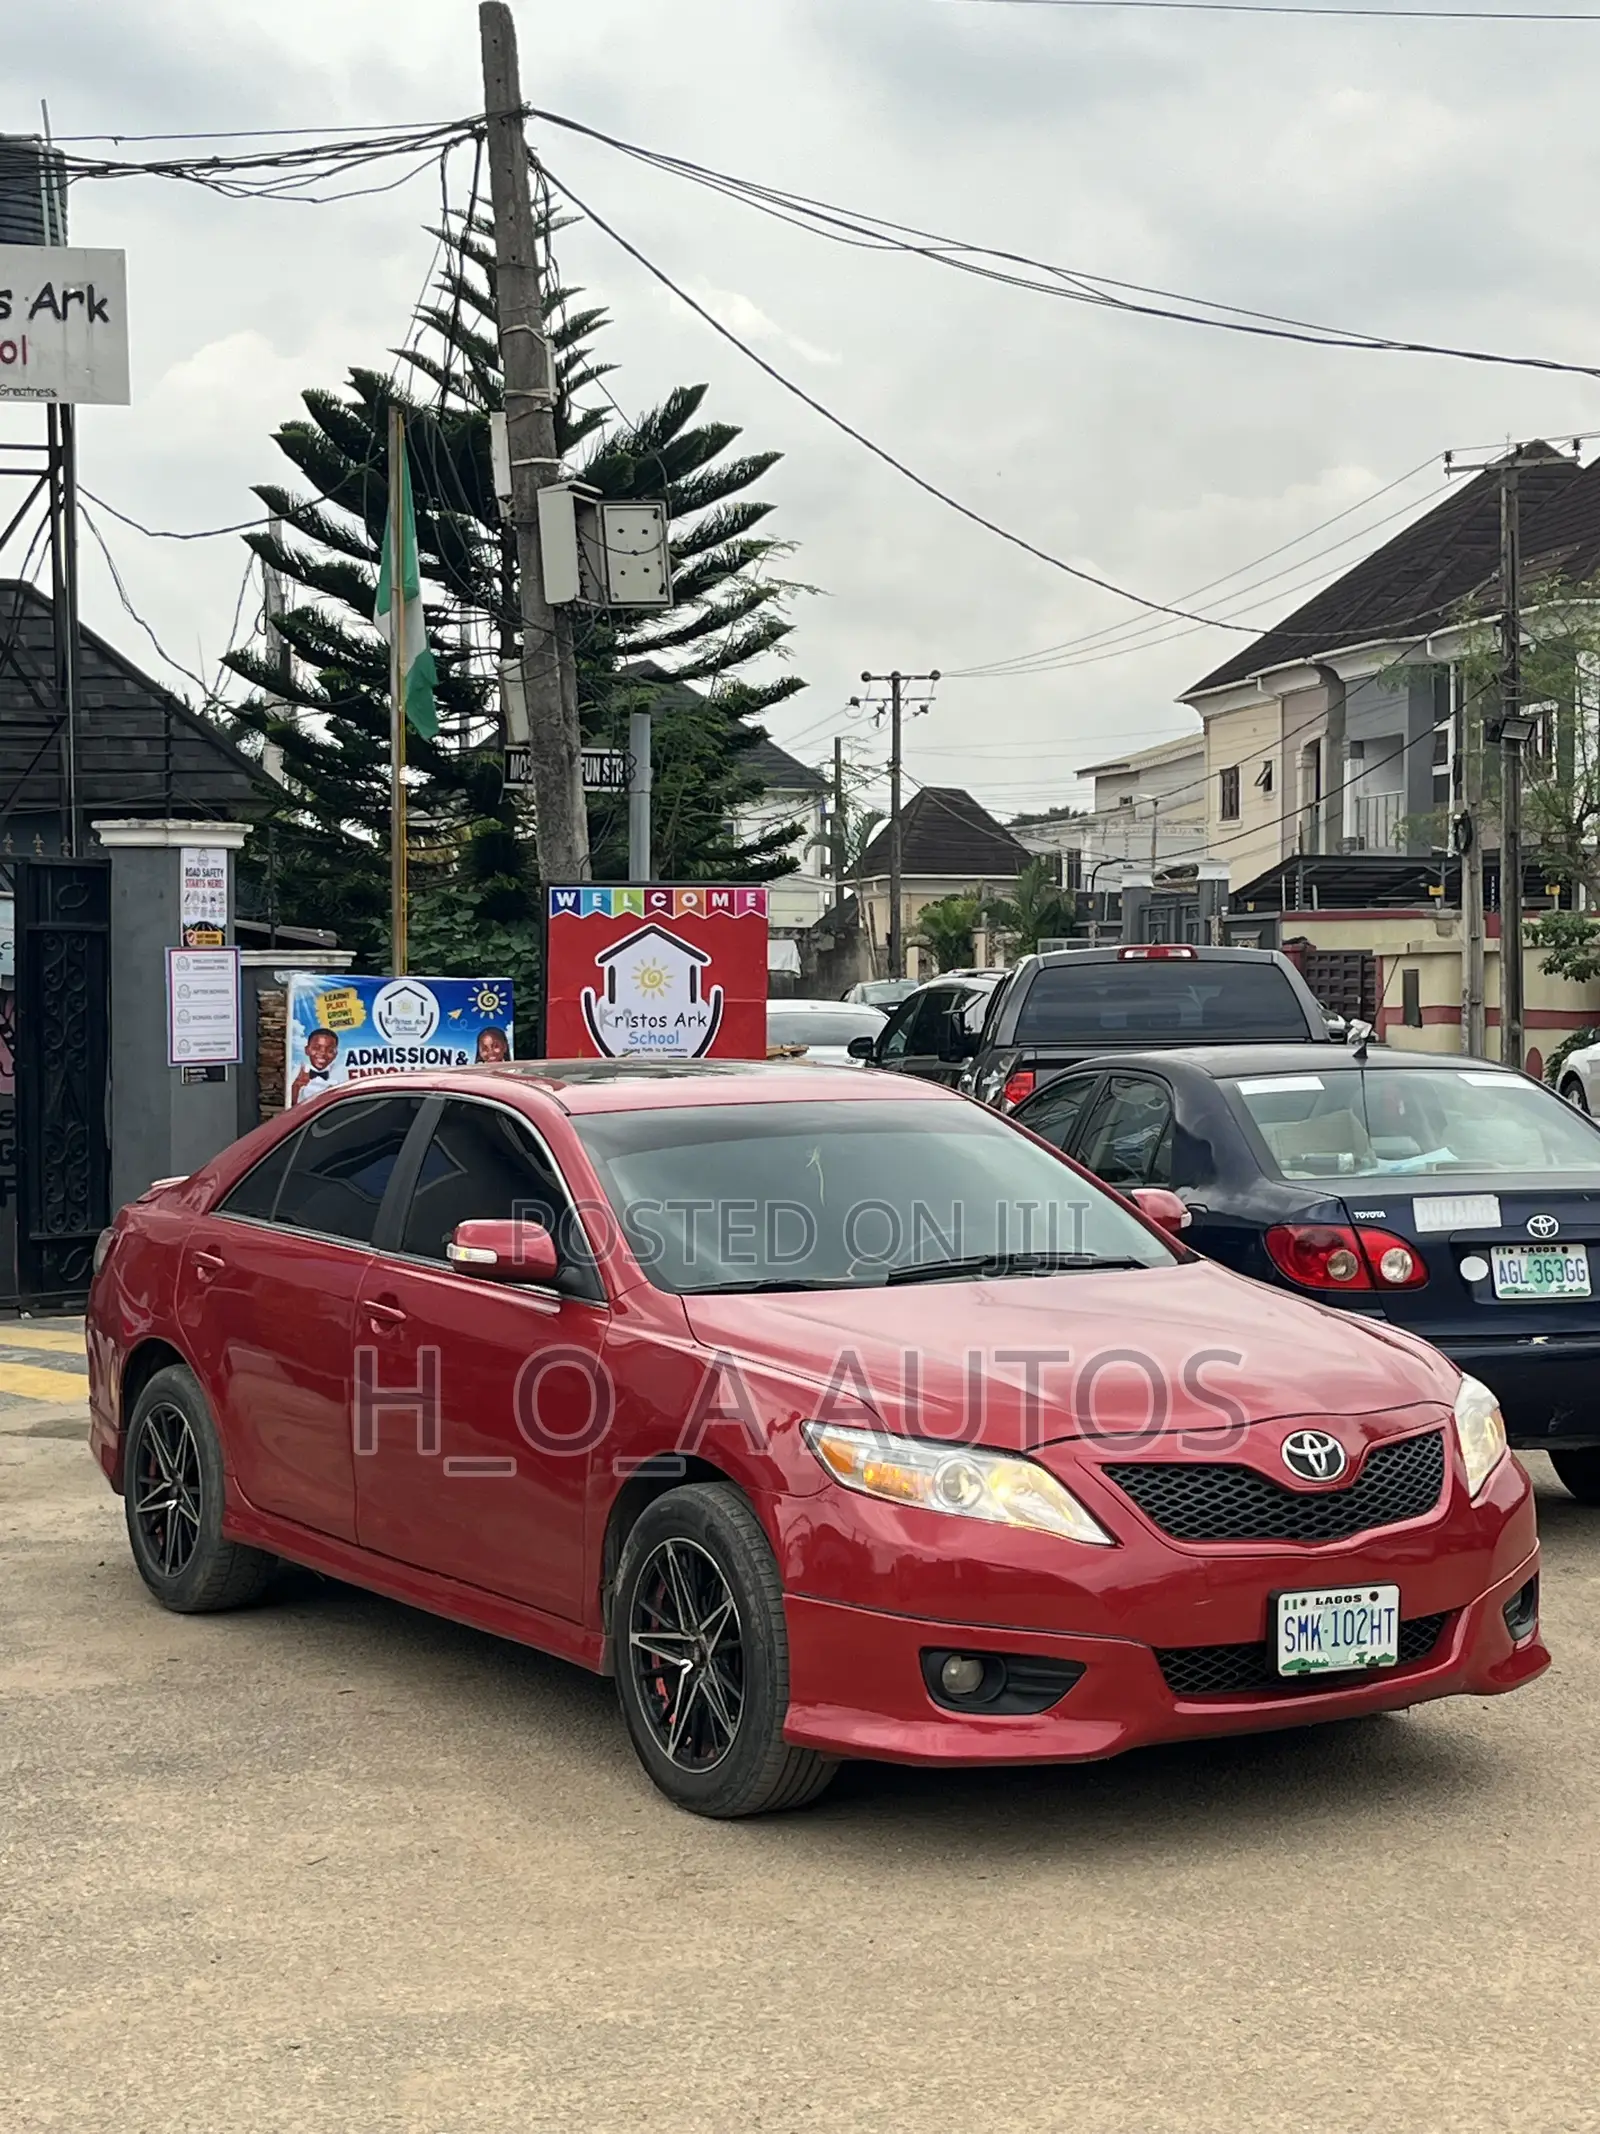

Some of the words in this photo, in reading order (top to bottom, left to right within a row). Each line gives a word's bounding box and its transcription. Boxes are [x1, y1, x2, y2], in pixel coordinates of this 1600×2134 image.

[28, 282, 110, 323] Ark
[0, 384, 57, 398] Greatness
[185, 867, 201, 877] ROAD
[202, 868, 224, 878] SAFETY
[556, 892, 757, 908] WELCOME
[599, 1004, 668, 1034] Kristos
[674, 1010, 708, 1028] Ark
[628, 1030, 679, 1045] School
[345, 1047, 453, 1067] ADMISSION
[455, 1050, 469, 1066] &
[1353, 1210, 1387, 1219] TOYOTA
[1520, 1246, 1557, 1254] LAGOS
[1315, 1594, 1362, 1606] LAGOS
